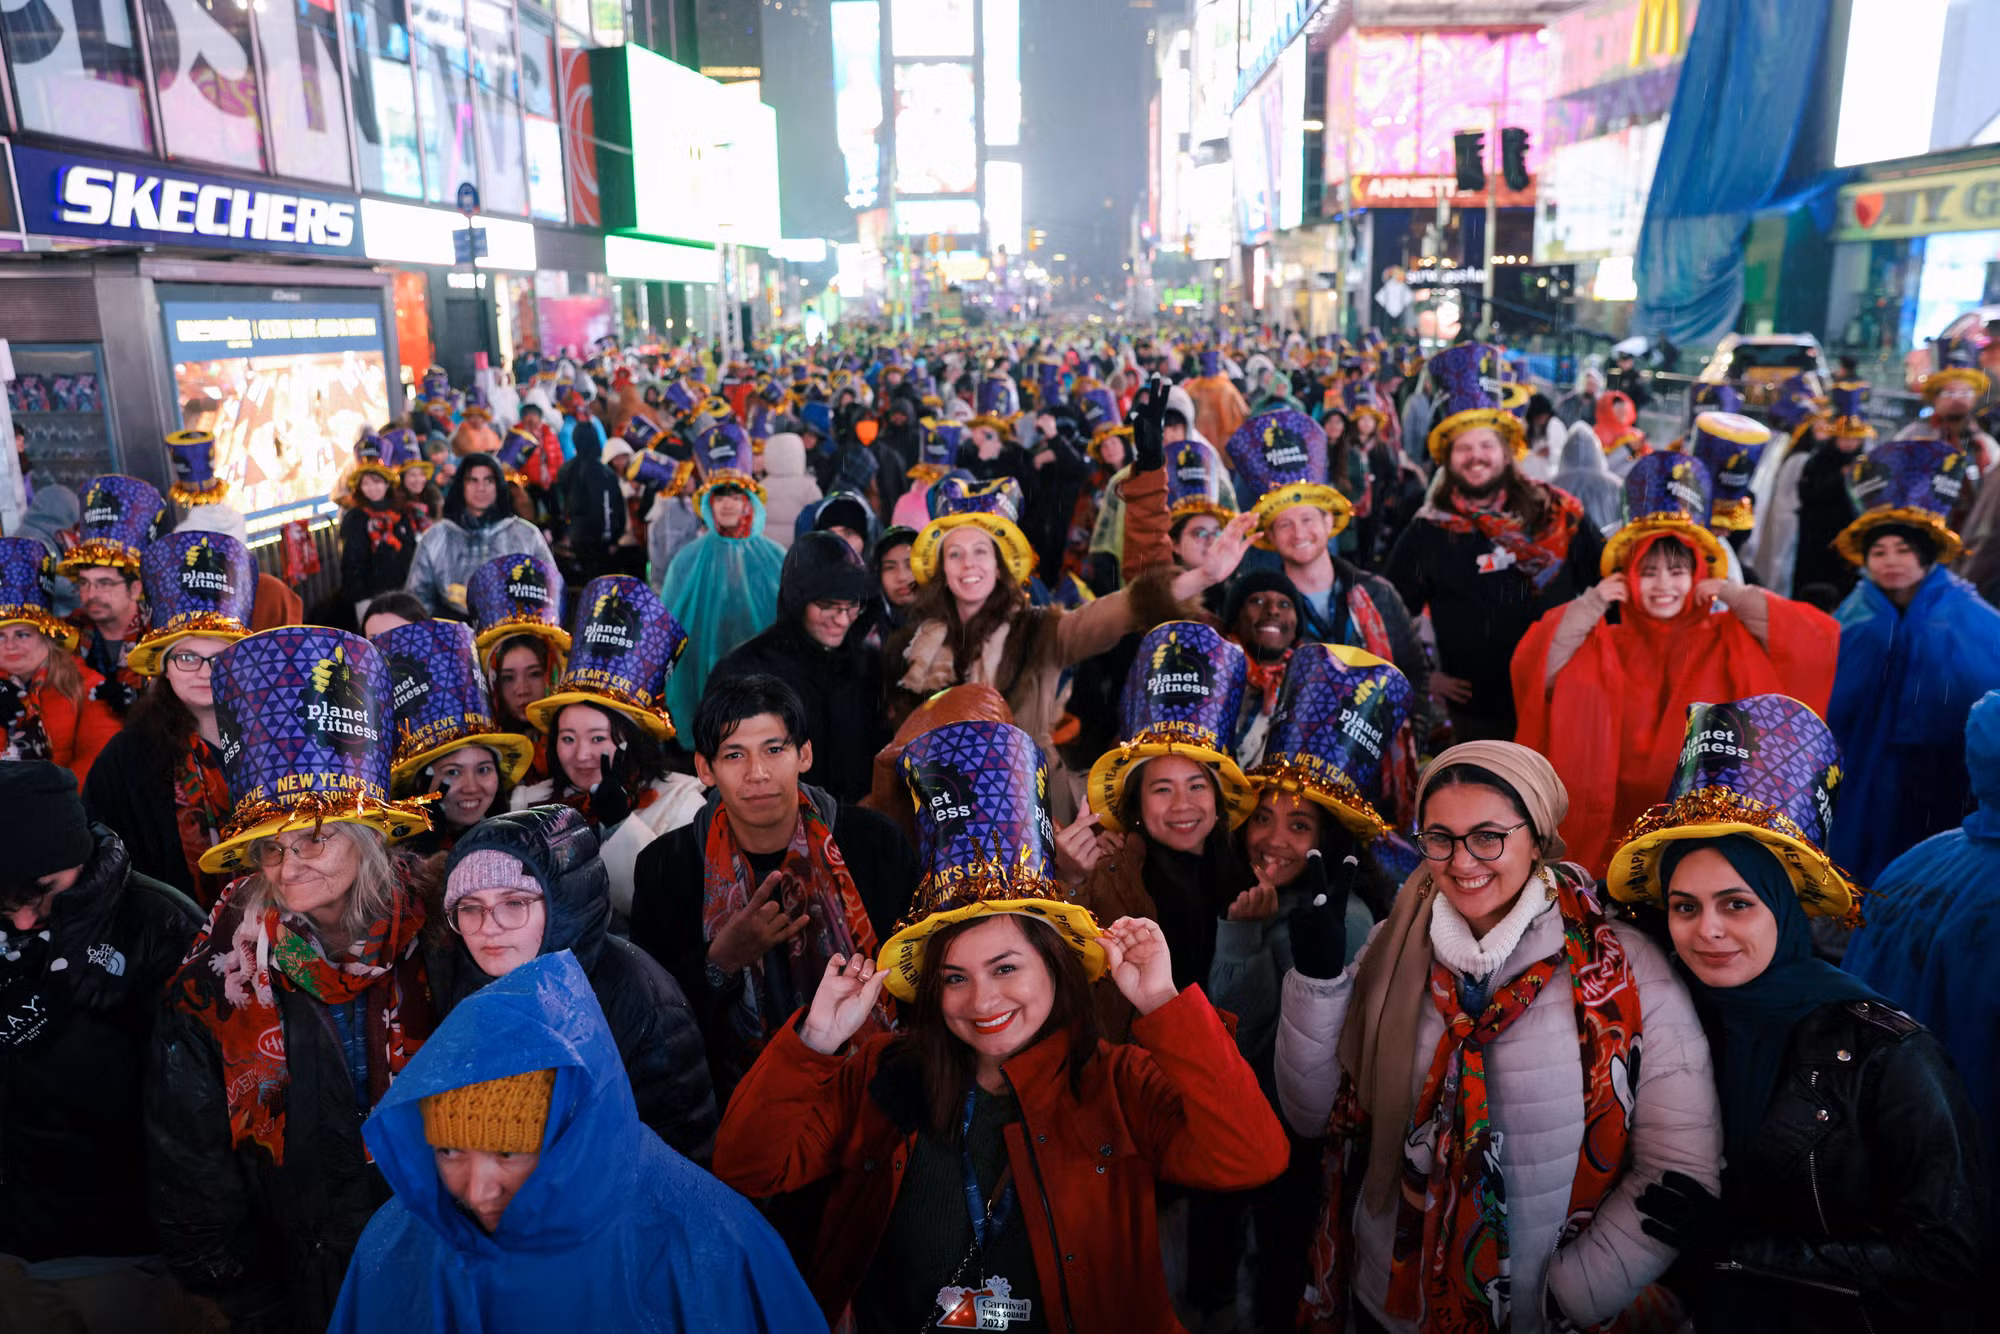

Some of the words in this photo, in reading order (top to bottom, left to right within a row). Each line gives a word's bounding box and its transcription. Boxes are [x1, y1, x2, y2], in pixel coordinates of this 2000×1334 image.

[1367, 177, 1474, 198] ARNETT
[63, 166, 354, 246] SKECHERS
[182, 570, 227, 583] planet
[188, 578, 235, 594] fitness
[584, 622, 627, 637] planet
[586, 632, 634, 648] fitness
[393, 675, 415, 697] net
[577, 668, 610, 682] YEAR'S
[612, 674, 632, 691] EVE
[1148, 672, 1199, 690] planet
[1153, 682, 1209, 696] fitness
[307, 701, 369, 725] planet
[318, 716, 378, 741] fitness
[433, 716, 457, 731] EVE
[1153, 720, 1195, 733] YEAR'S
[1339, 708, 1383, 743] planet
[1342, 721, 1381, 760] fitness
[1294, 752, 1324, 769] NEW
[245, 784, 265, 806] EVE
[277, 773, 314, 793] NEW
[319, 773, 367, 792] YEAR'S
[370, 783, 385, 801] EVE
[0, 998, 38, 1035] AY
[13, 1033, 28, 1046] TIMES
[27, 1017, 48, 1035] SQUARE
[982, 1300, 1027, 1311] Carnival
[982, 1319, 1005, 1328] 2023
[1003, 1311, 1027, 1319] SQUARE
